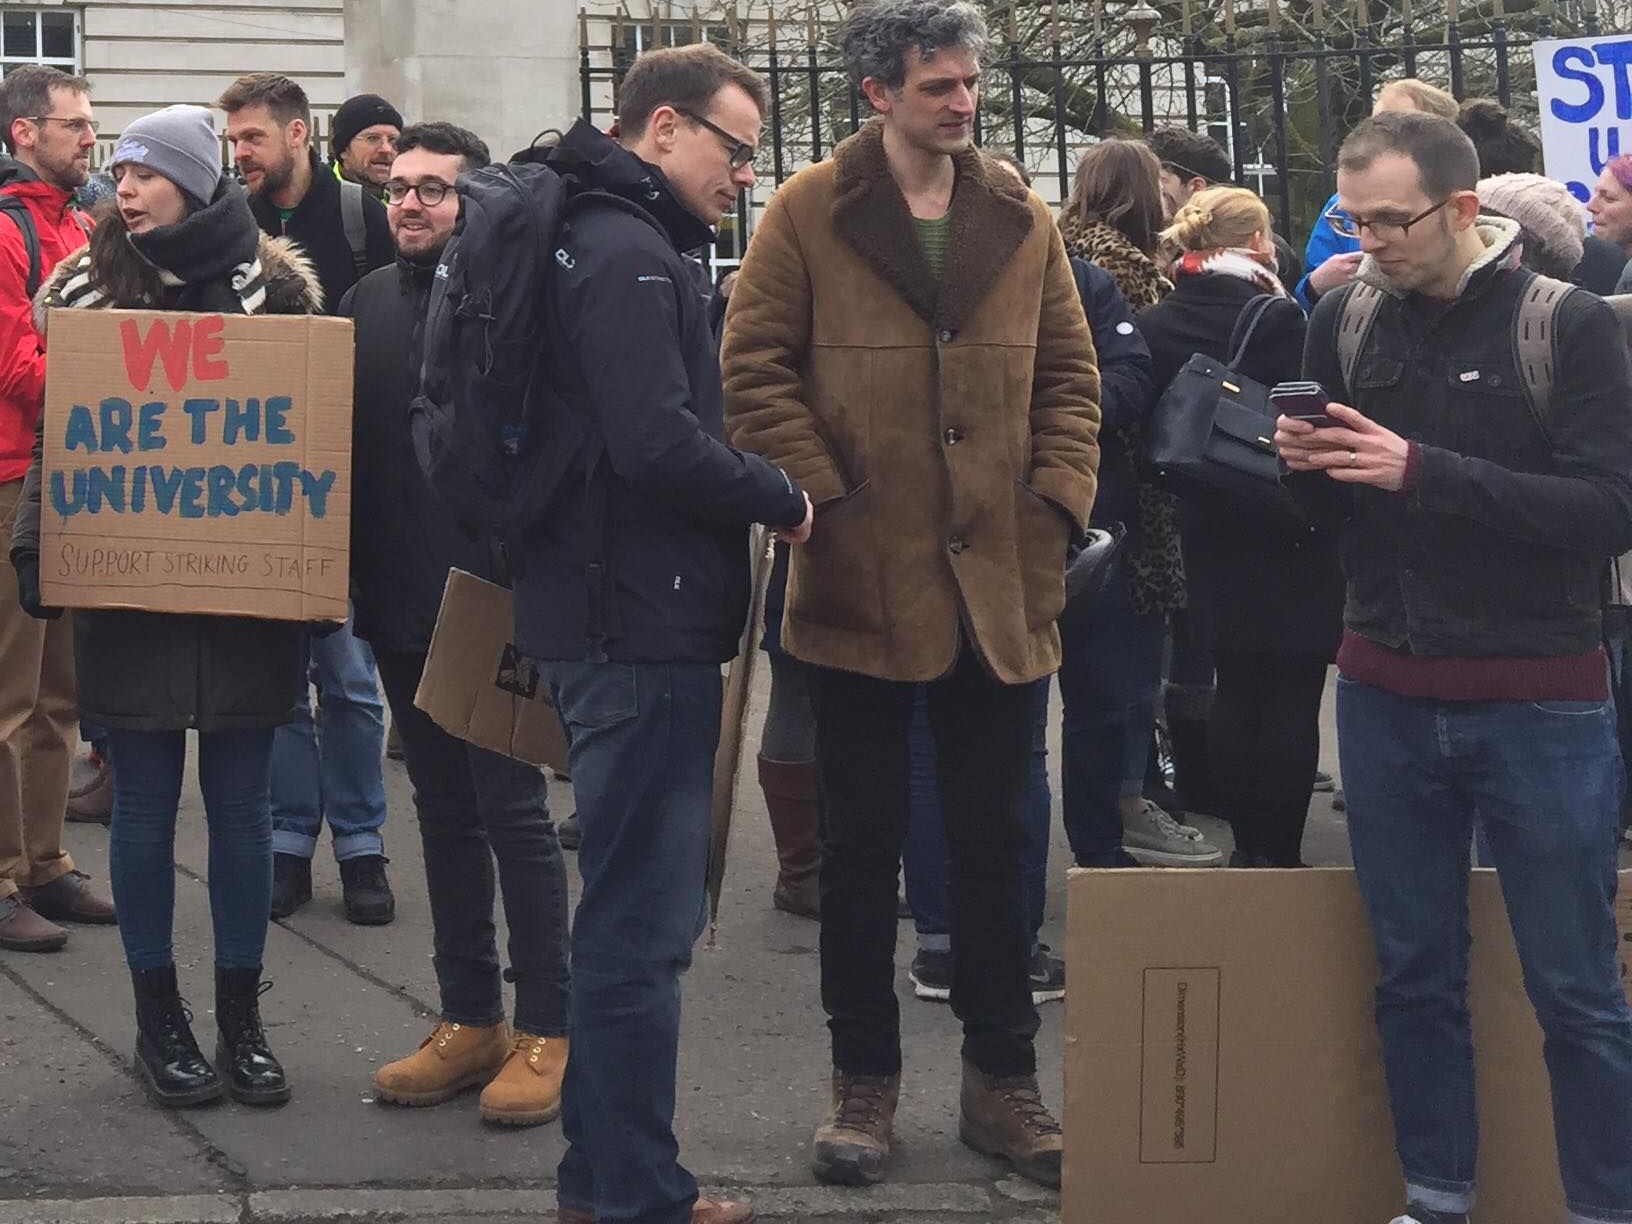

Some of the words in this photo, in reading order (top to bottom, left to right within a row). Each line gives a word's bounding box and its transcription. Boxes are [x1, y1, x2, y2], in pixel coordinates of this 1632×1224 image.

[119, 315, 229, 392] WE
[65, 397, 167, 454] ARE
[183, 396, 295, 445] THE
[49, 461, 336, 519] UNIVERSITY
[59, 543, 154, 576] SUPPORT
[162, 551, 249, 576] STRIKING
[263, 553, 336, 579] STAFF
